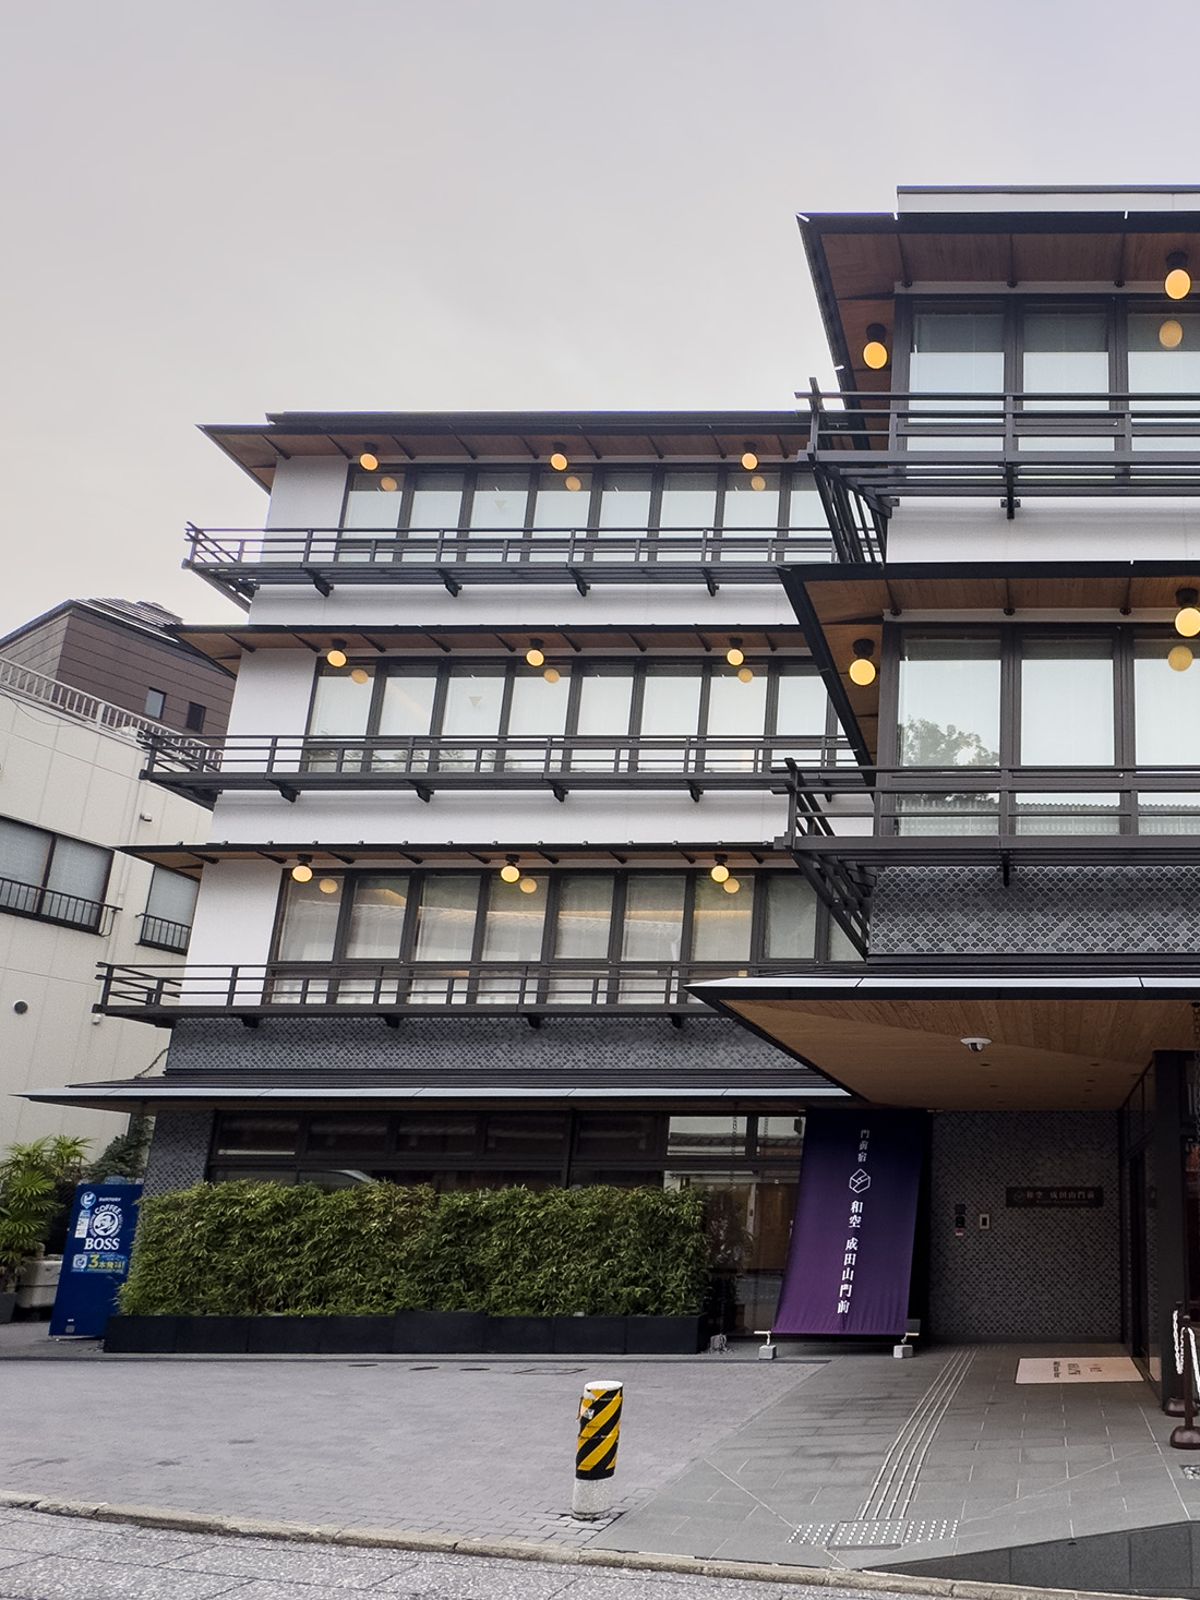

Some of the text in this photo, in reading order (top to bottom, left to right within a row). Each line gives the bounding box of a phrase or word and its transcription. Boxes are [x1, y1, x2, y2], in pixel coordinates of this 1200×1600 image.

[857, 1130, 870, 1162] 門前宿
[94, 1204, 122, 1215] COFFEE
[84, 1238, 121, 1250] BOSS
[837, 1200, 864, 1314] 和空 成田山門前
